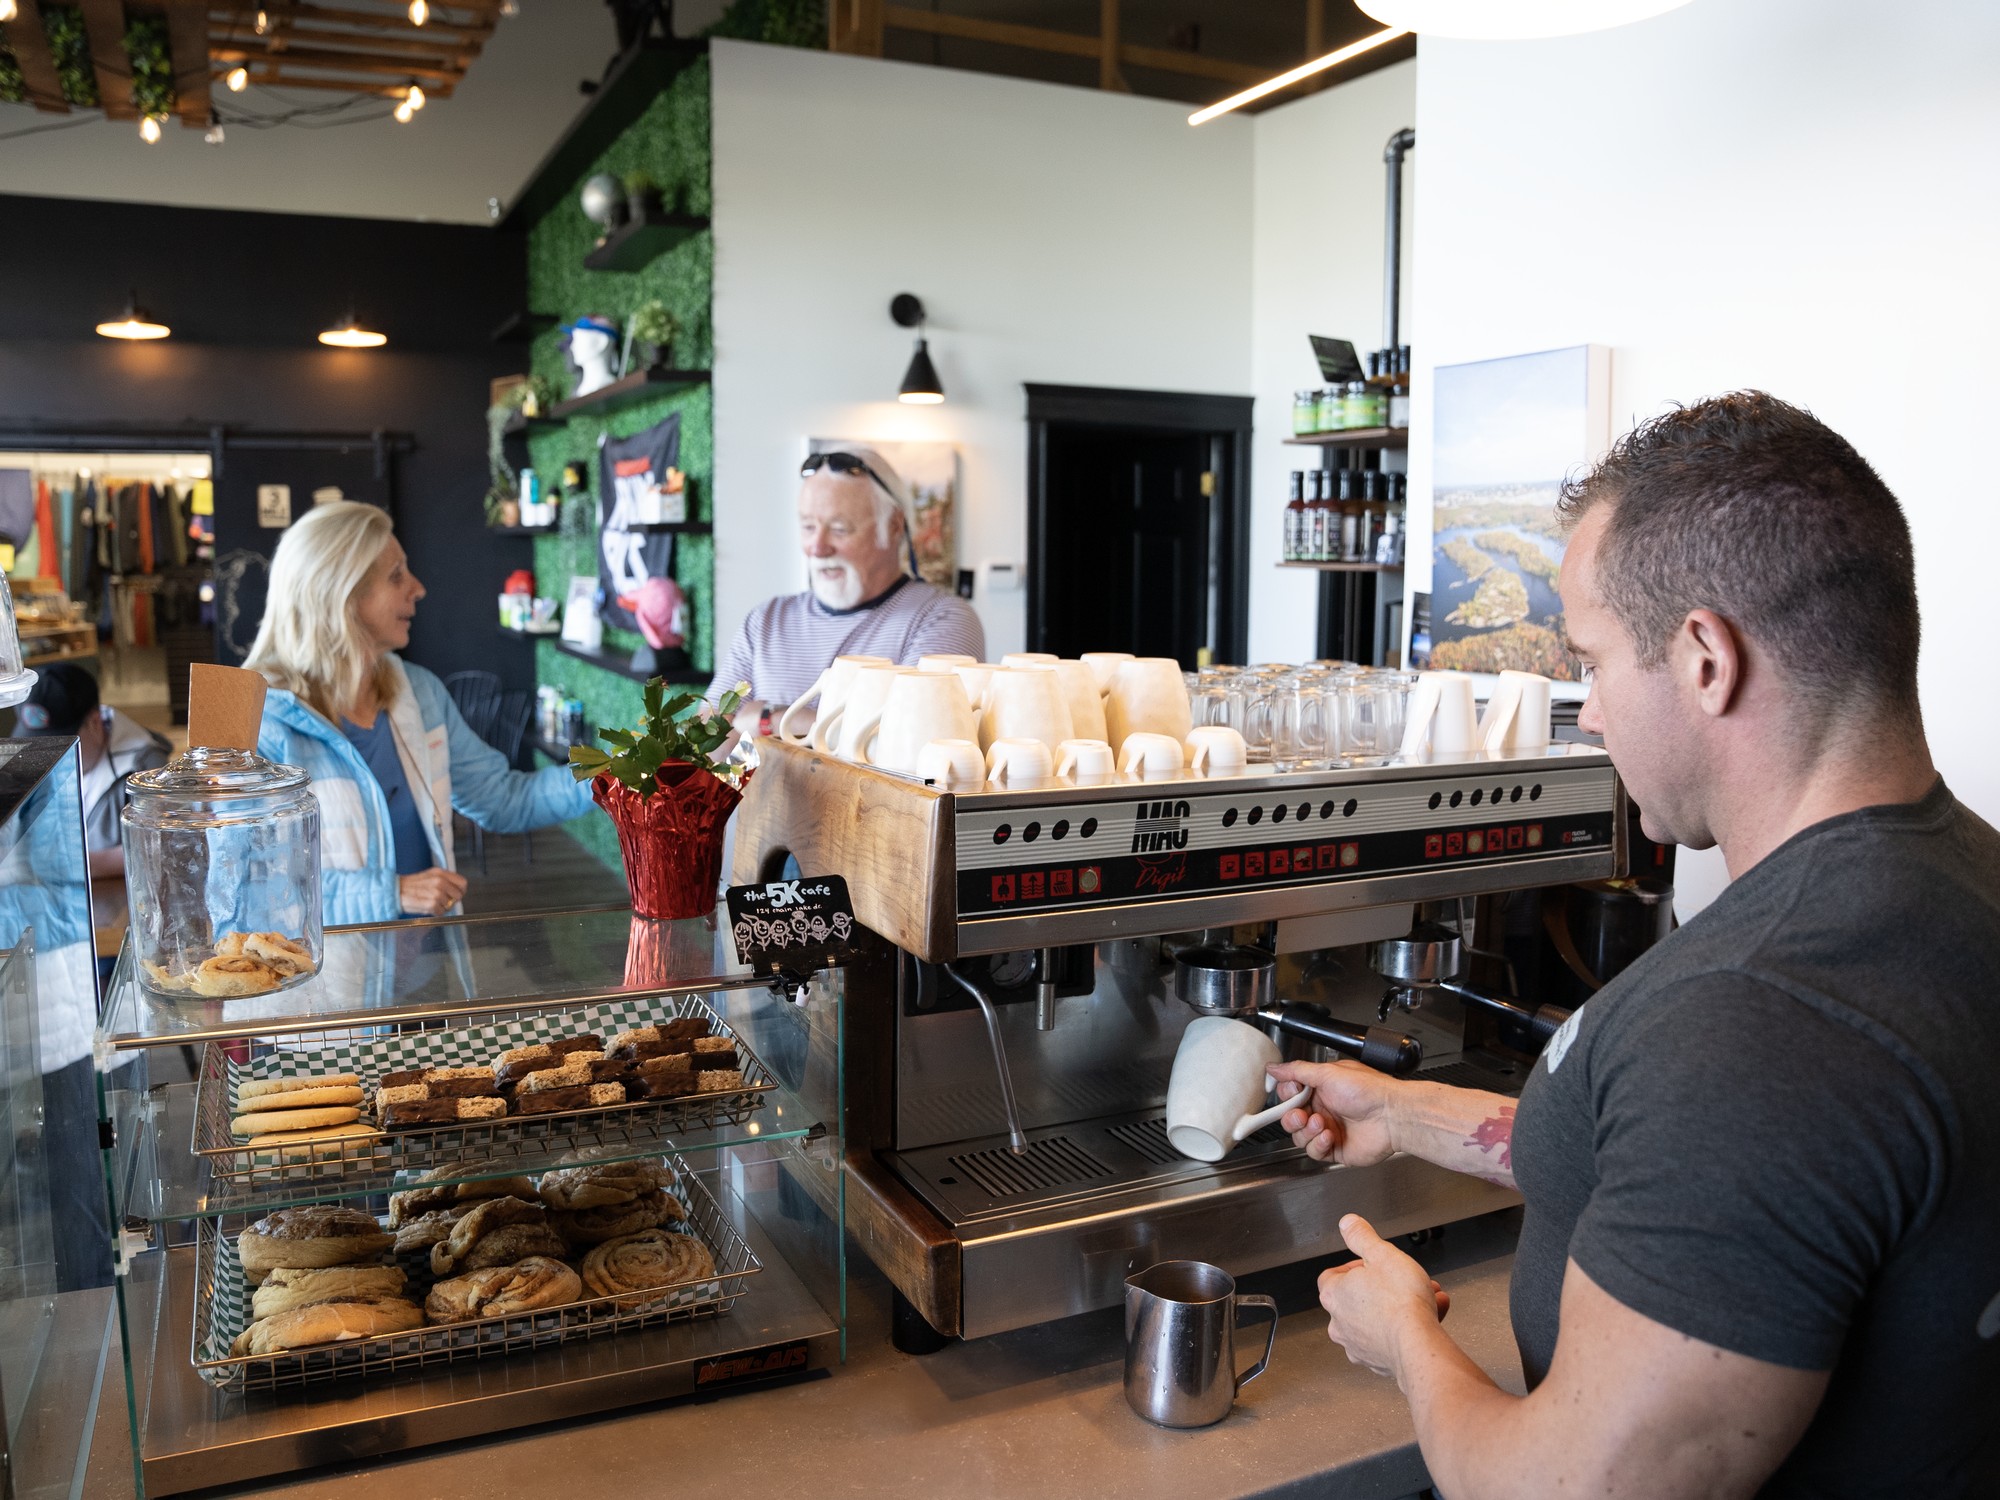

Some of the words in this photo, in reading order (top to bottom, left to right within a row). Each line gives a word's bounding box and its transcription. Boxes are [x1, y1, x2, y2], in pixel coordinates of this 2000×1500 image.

[1131, 800, 1190, 853] MAC
[1135, 866, 1186, 893] Digit
[744, 890, 766, 901] the
[766, 880, 805, 907] 5K
[801, 885, 831, 896] cafe
[772, 904, 793, 913] chain
